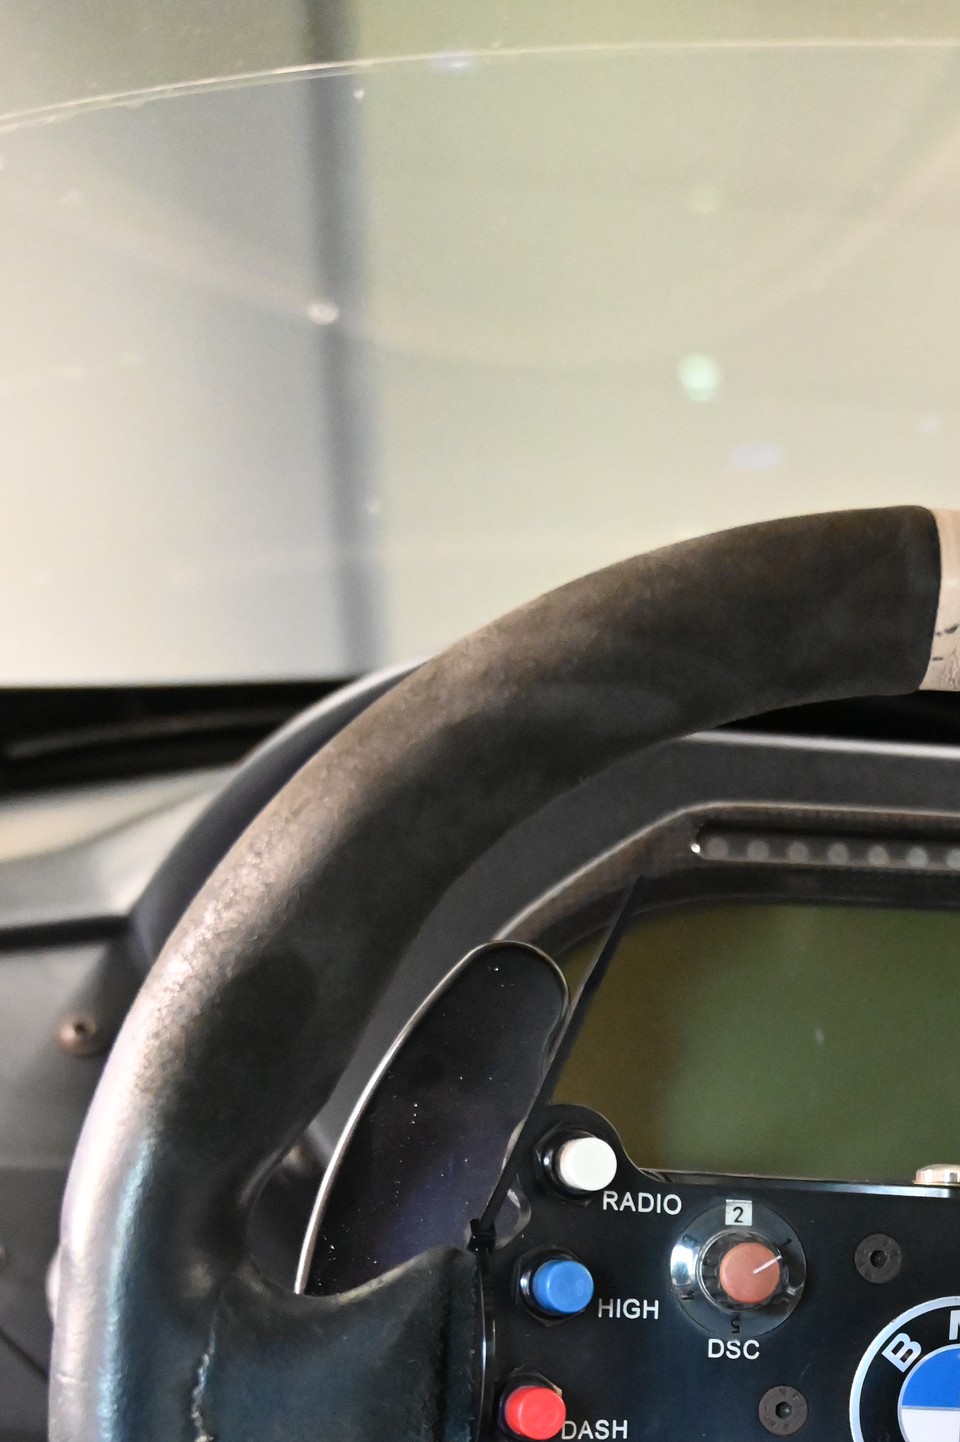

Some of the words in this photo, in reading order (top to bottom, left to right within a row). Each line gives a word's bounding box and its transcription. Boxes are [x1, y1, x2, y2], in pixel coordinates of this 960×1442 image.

[602, 1190, 682, 1215] RADIO
[732, 1206, 744, 1223] 2
[598, 1298, 659, 1320] HIGH
[707, 1338, 760, 1360] DSC
[561, 1419, 628, 1440] DASH
